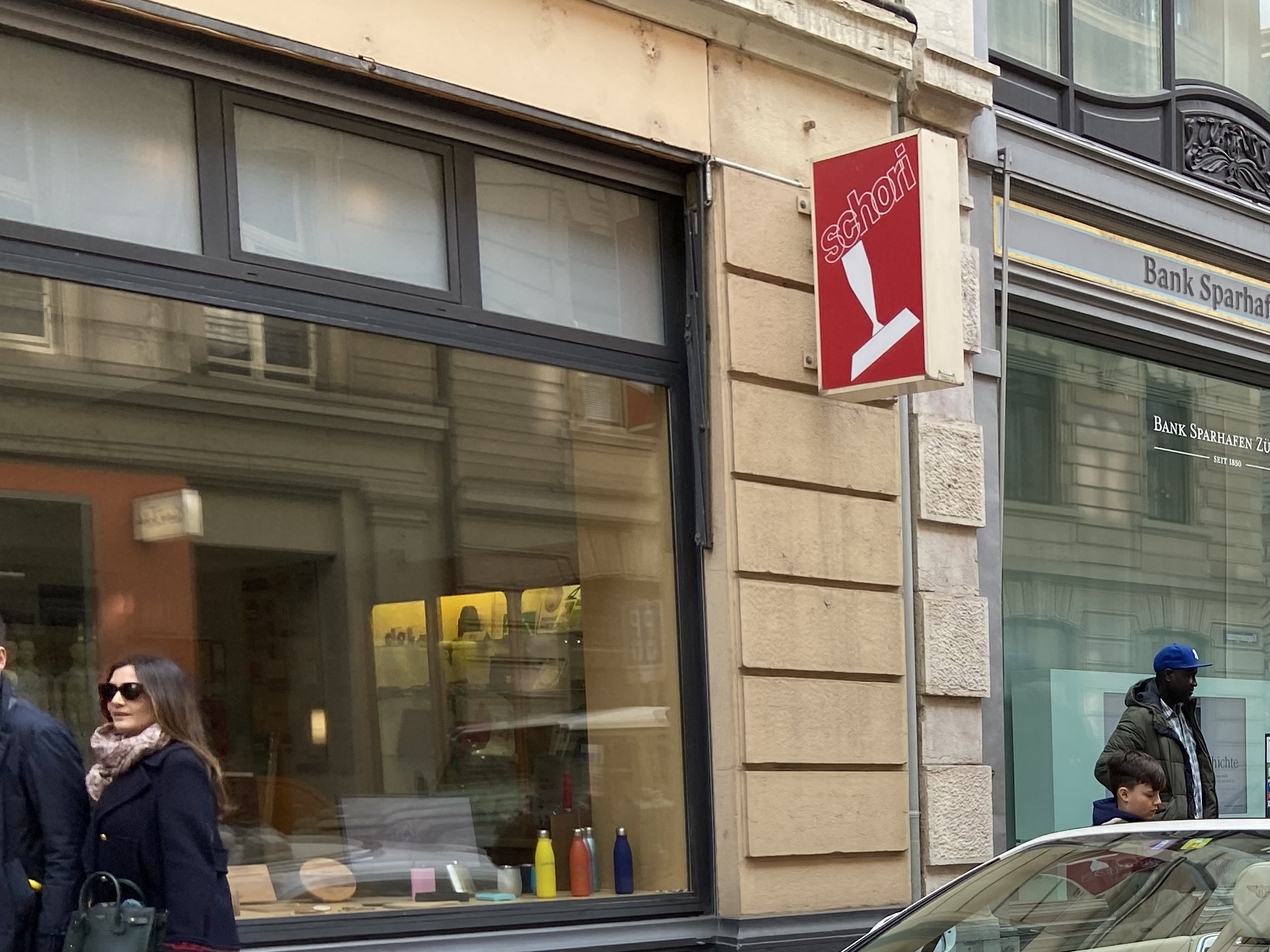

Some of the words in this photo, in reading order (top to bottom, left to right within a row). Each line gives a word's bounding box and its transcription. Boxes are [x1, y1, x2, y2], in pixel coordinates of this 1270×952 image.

[821, 143, 916, 264] schori
[1143, 255, 1194, 297] Bank
[1153, 415, 1187, 438] BANK
[1190, 423, 1253, 450] SPARHAFEN
[1213, 455, 1228, 465] SEIT
[1229, 458, 1242, 467] 1850
[1211, 756, 1239, 769] hichte
